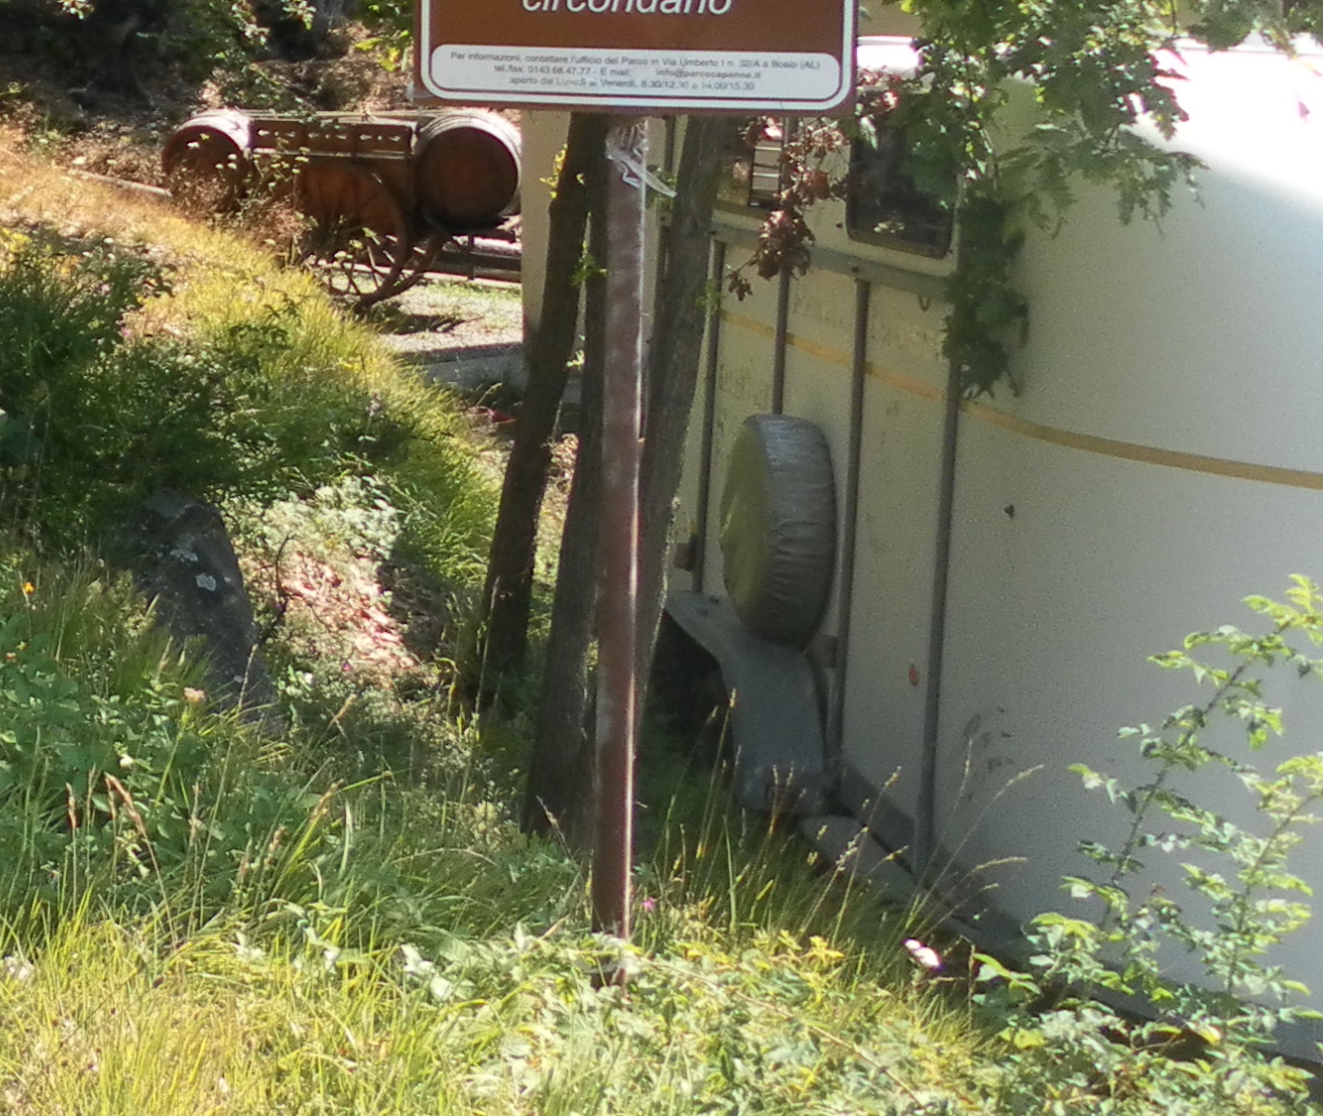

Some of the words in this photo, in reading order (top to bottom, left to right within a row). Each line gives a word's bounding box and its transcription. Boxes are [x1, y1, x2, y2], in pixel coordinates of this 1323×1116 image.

[451, 51, 465, 59] Per
[525, 55, 568, 63] contattare
[604, 56, 619, 65] del
[621, 57, 648, 66] Parco
[662, 58, 677, 66] Via
[679, 58, 719, 67] Umberto
[800, 60, 821, 70] (AL)
[600, 67, 607, 75] E
[656, 69, 761, 79] info@parcocapanne.it
